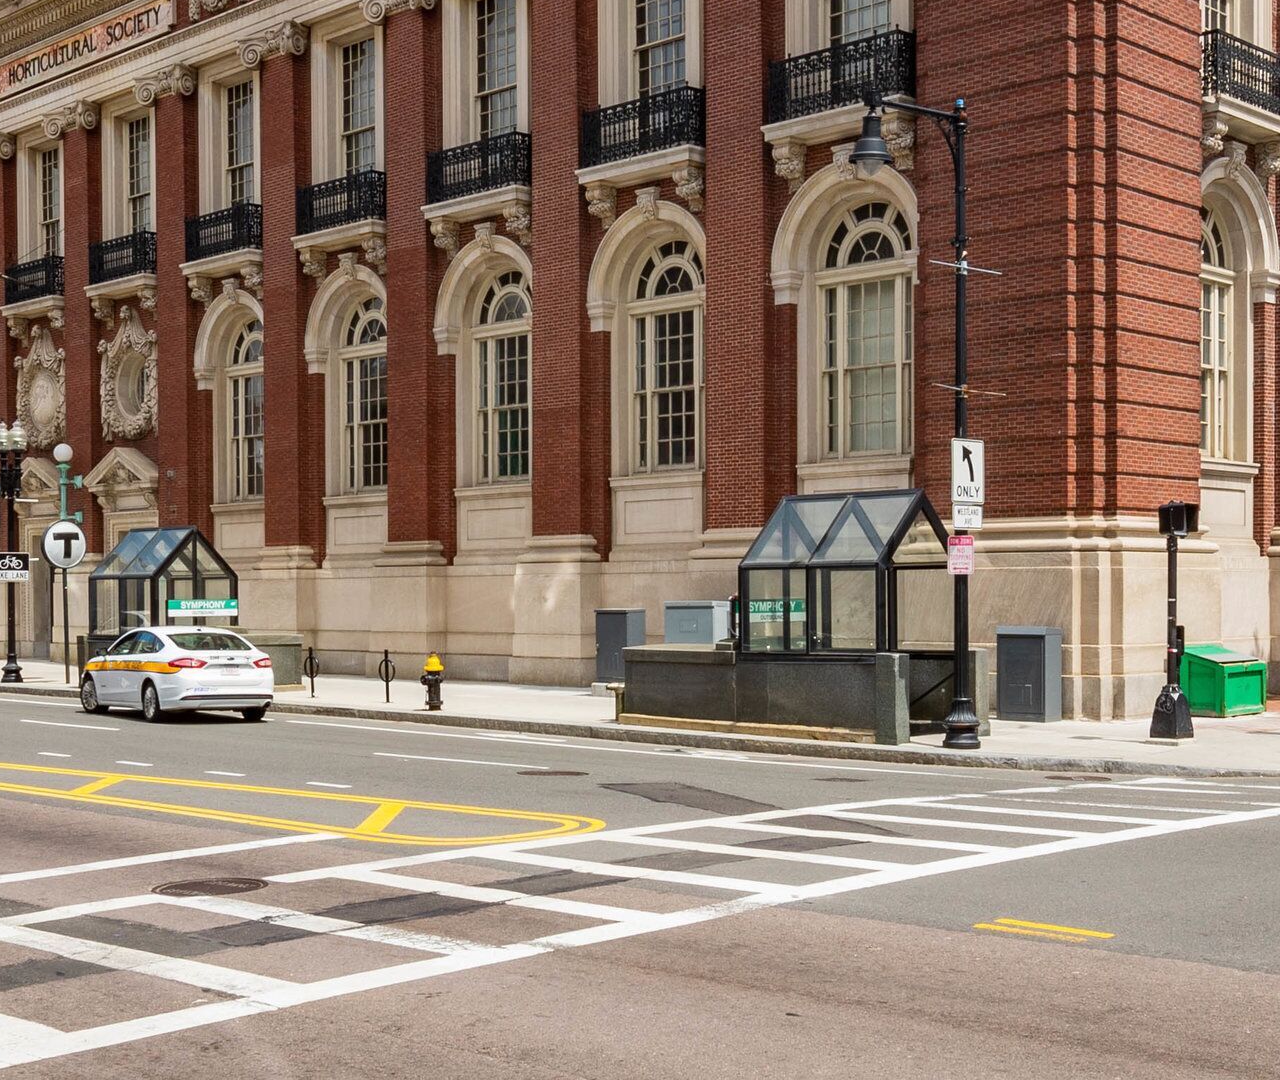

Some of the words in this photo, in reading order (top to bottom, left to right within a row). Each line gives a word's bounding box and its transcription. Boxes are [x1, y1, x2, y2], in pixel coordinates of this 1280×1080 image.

[8, 33, 97, 86] HORTICULTURAL
[106, 4, 161, 45] SOCIETY
[956, 485, 980, 498] ONLY
[53, 532, 80, 559] T
[12, 571, 28, 580] LANE
[180, 600, 226, 609] SYMPHONY
[749, 601, 796, 612] SYMPHOY
